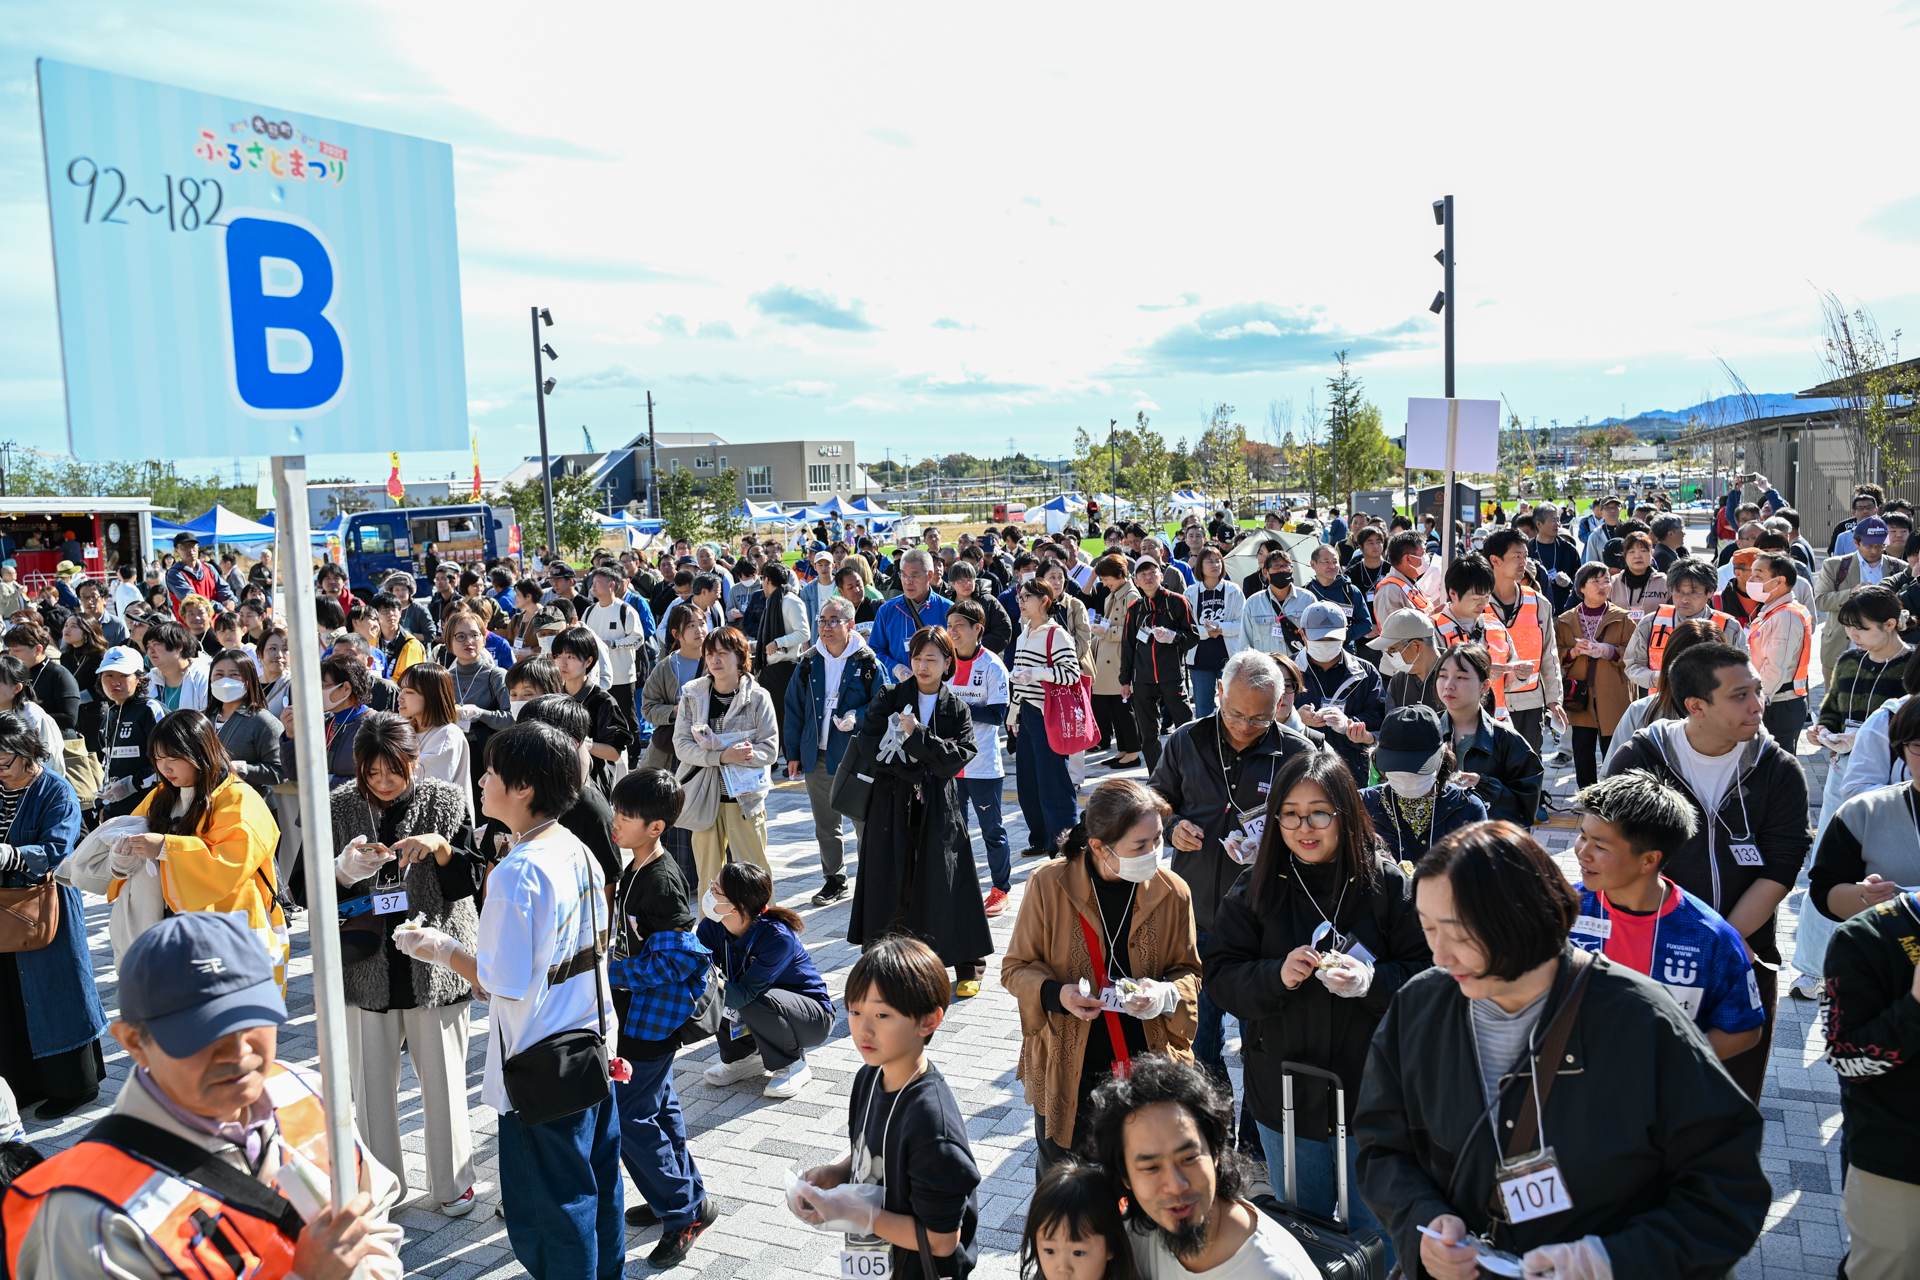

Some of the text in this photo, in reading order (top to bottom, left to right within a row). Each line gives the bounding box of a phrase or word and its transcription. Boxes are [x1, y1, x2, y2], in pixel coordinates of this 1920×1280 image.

[197, 131, 345, 183] ふるさとまつり
[226, 217, 345, 410] B
[1274, 628, 1283, 636] 19
[826, 699, 835, 707] 77
[1734, 847, 1759, 862] 133
[381, 895, 400, 910] 37
[1666, 943, 1700, 953] FUKUSHIMA
[1104, 993, 1123, 1008] 11
[1510, 1175, 1555, 1212] 107
[845, 1255, 886, 1276] 105
